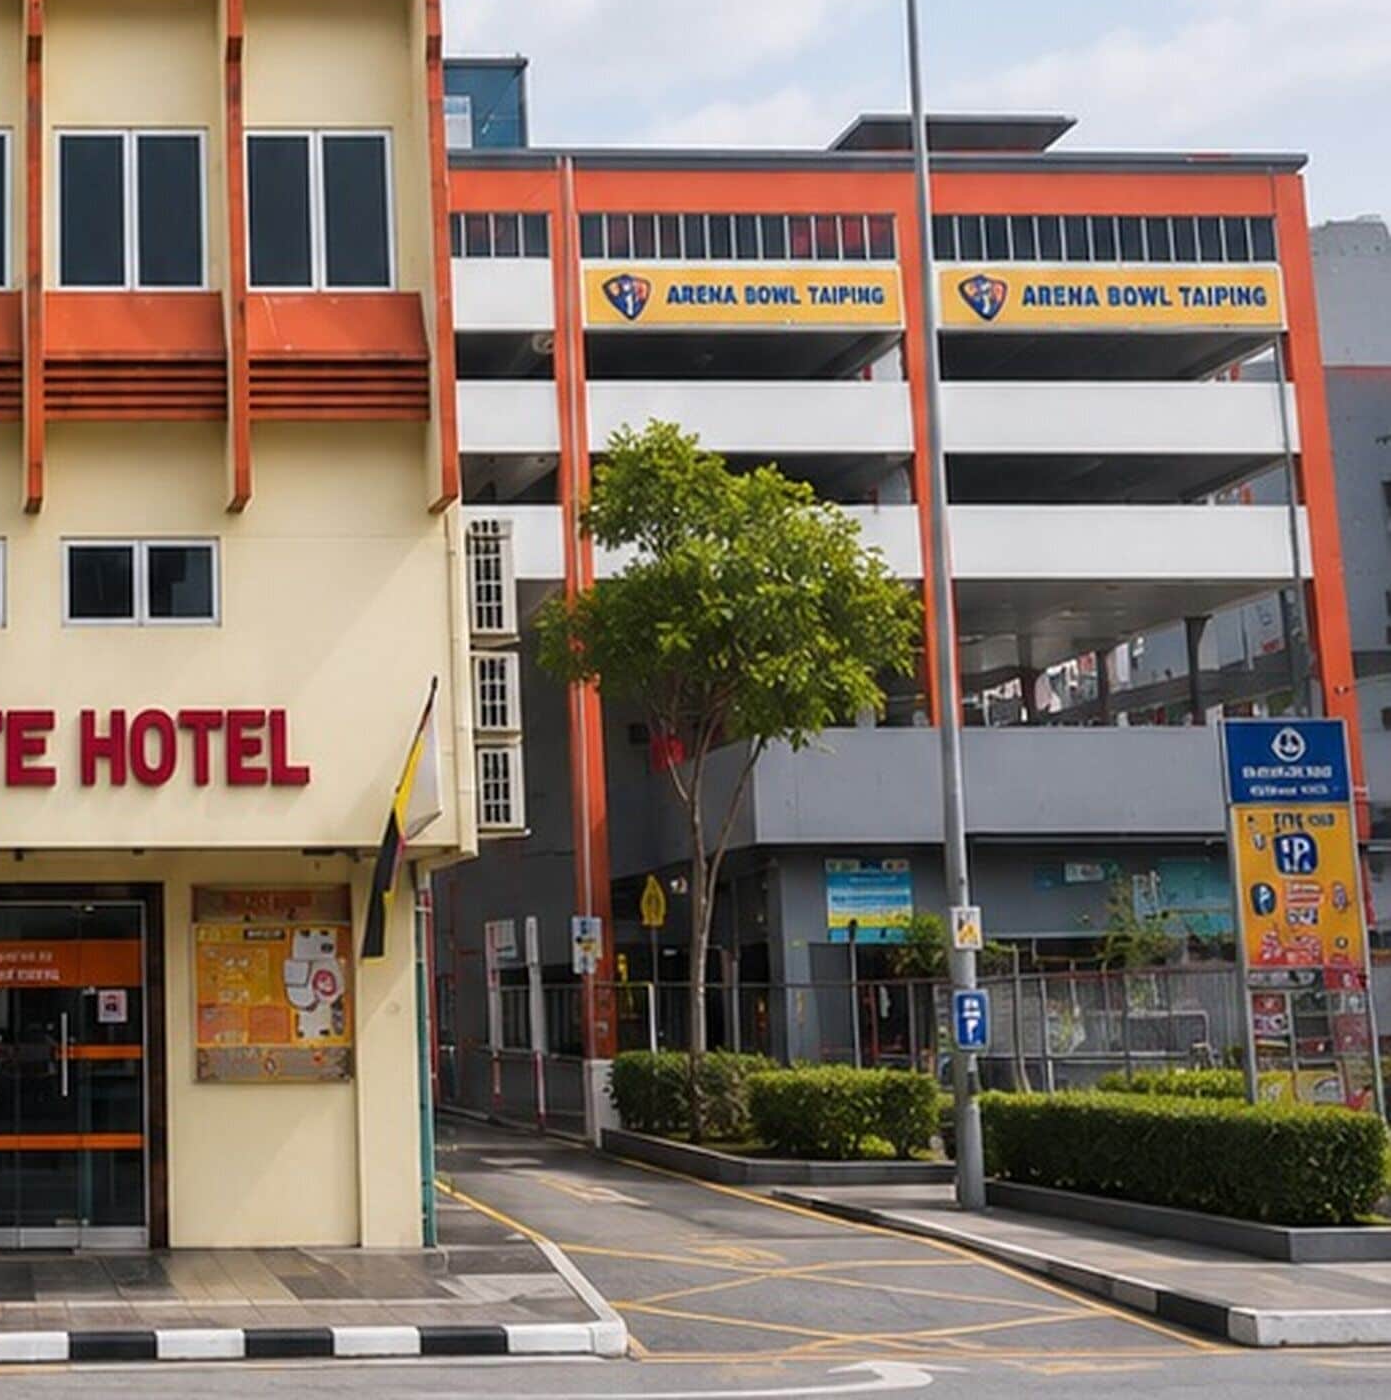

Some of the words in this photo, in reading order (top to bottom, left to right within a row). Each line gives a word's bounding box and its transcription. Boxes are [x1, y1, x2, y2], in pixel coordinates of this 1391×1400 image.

[744, 285, 802, 304] BOWL
[1107, 285, 1173, 306] BOWL
[1178, 285, 1267, 306] TAIPING
[80, 708, 311, 788] HOTEL
